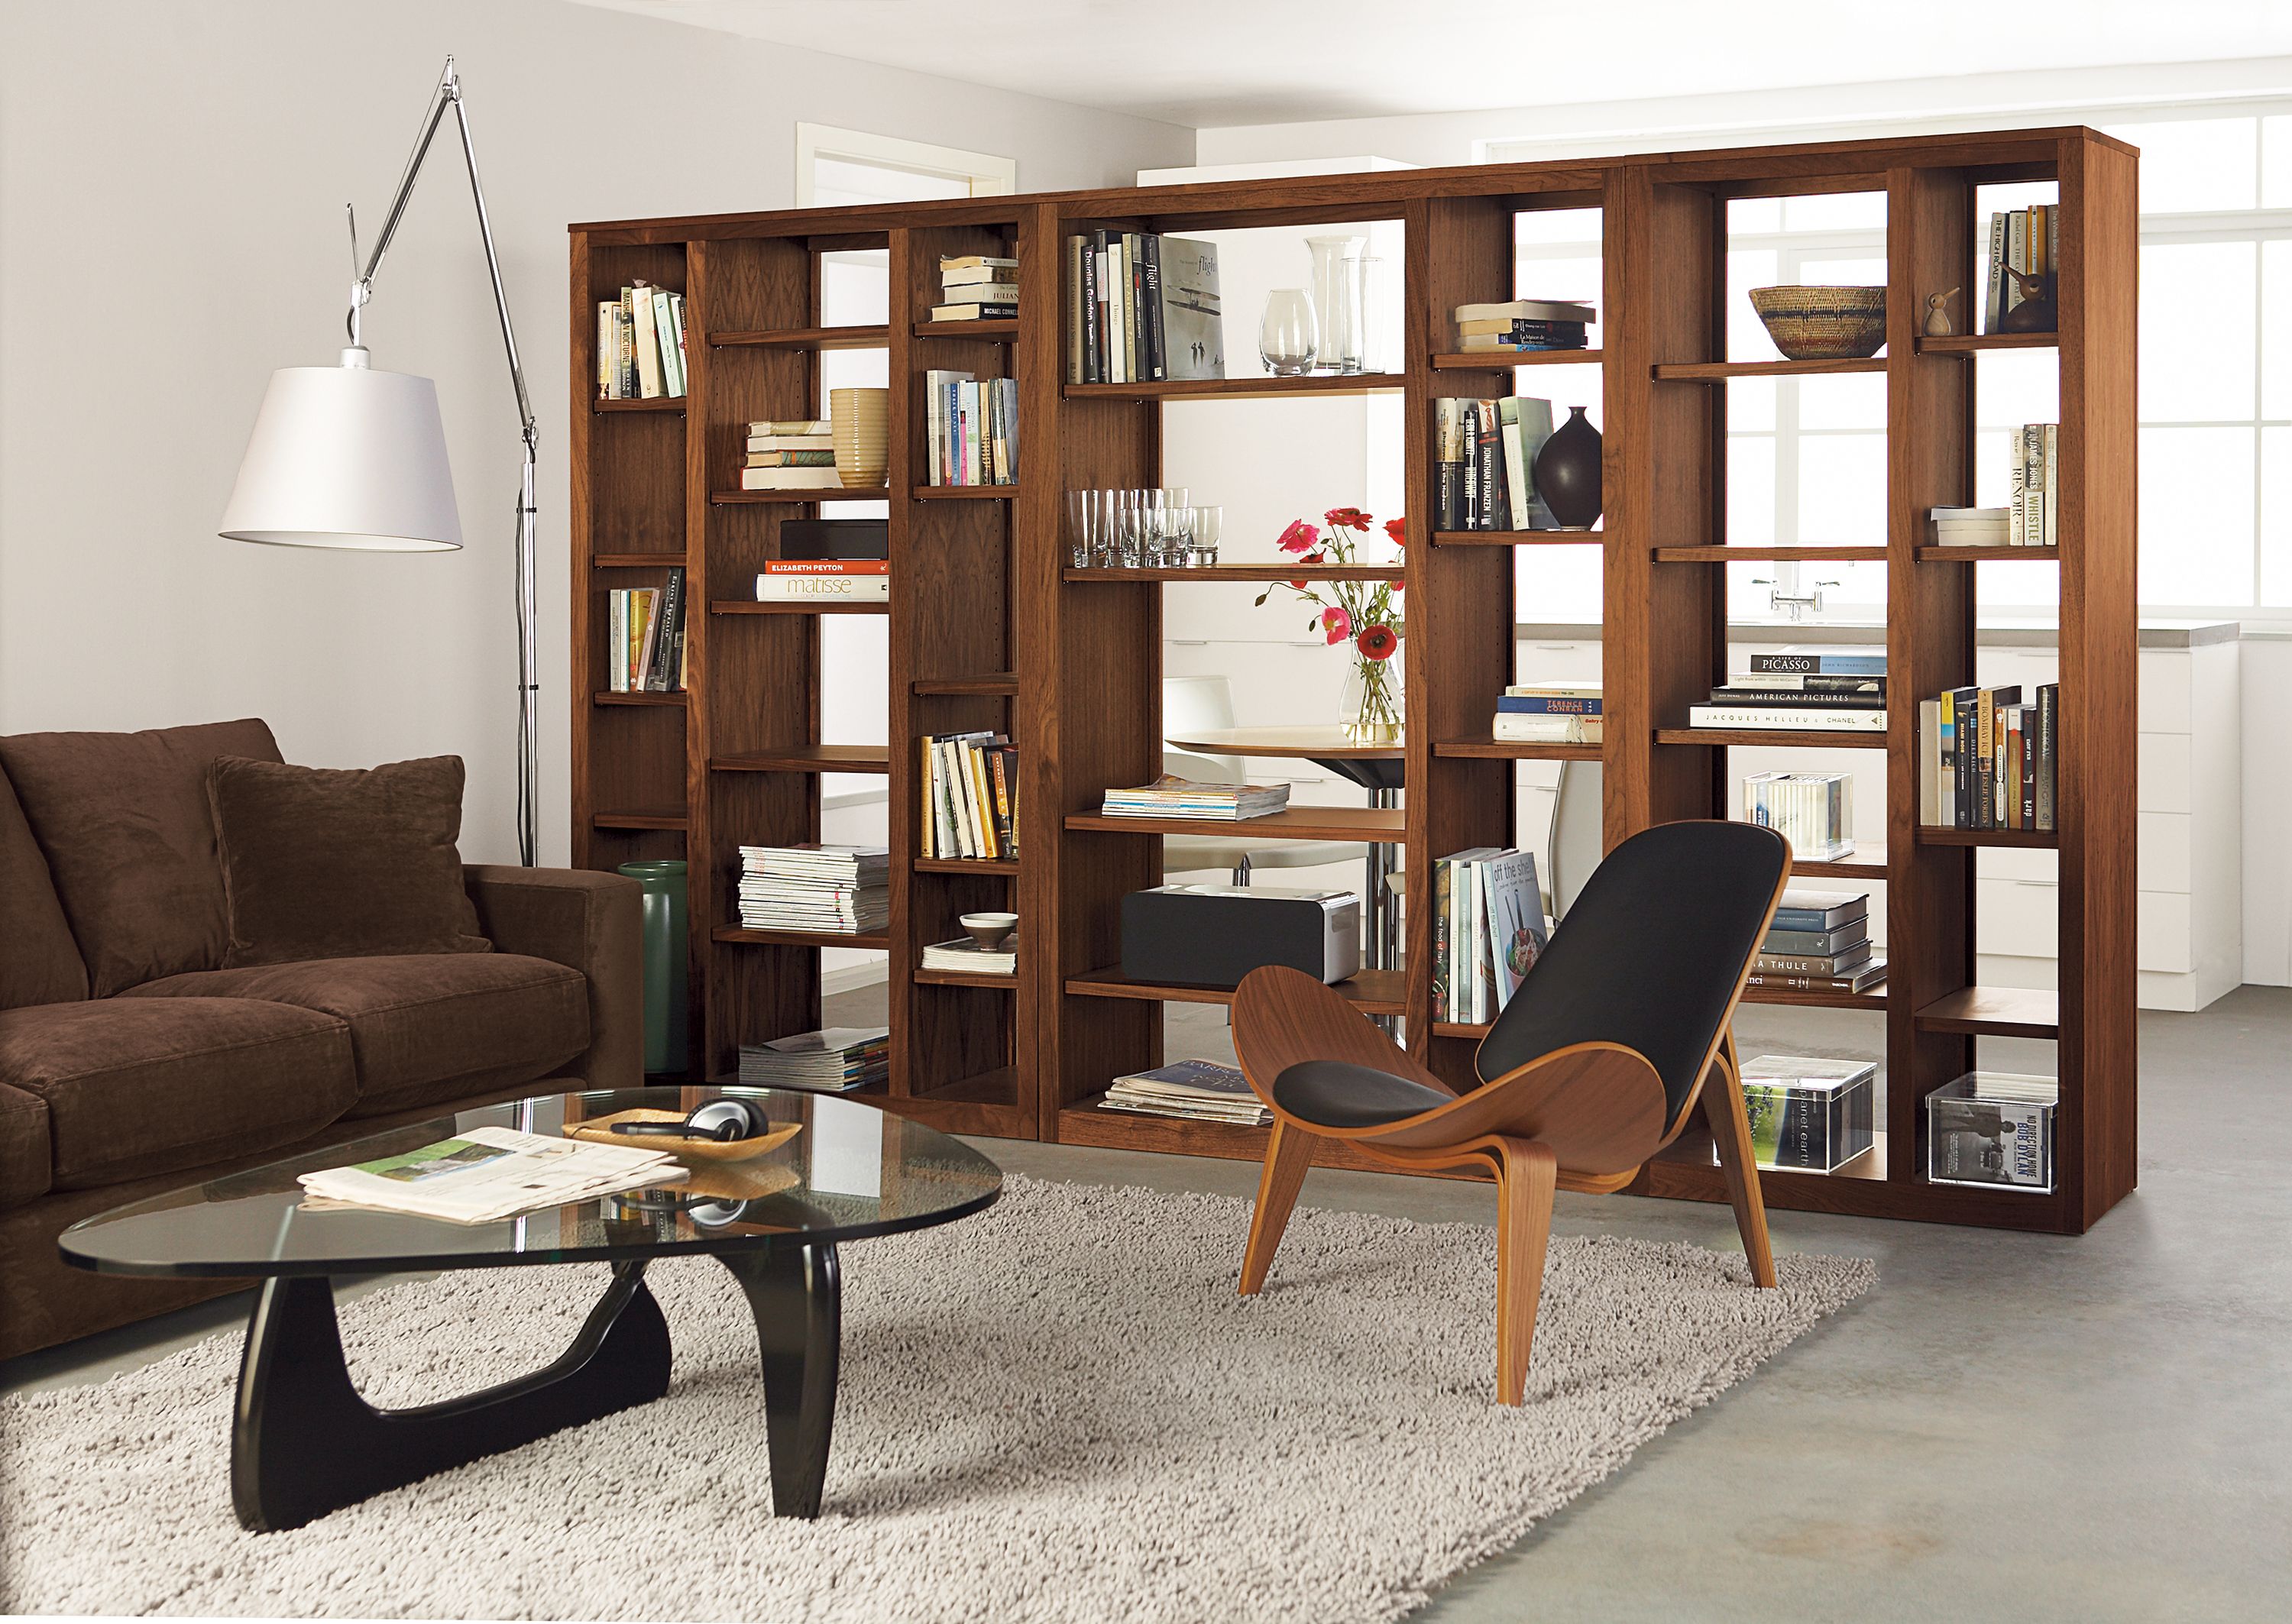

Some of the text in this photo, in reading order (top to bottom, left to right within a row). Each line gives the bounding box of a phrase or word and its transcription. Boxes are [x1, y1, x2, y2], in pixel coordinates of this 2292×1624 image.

[1085, 251, 1093, 286] Douglas
[1145, 262, 1157, 290] flight
[1442, 463, 1445, 471] on
[2029, 467, 2038, 490] JONES
[2012, 467, 2022, 516] RENOIR
[2028, 496, 2039, 541] WHISTLE
[788, 577, 851, 594] matisse
[665, 603, 674, 638] REVEALED
[1763, 660, 1811, 670] PICASSO
[2024, 800, 2032, 817] dark
[1494, 864, 1503, 882] off
[1504, 862, 1516, 879] the
[1771, 960, 1808, 970] THULE
[2018, 1123, 2028, 1175] BOB DYLAN
[2027, 1115, 2037, 1178] NO DIRECTION HOME
